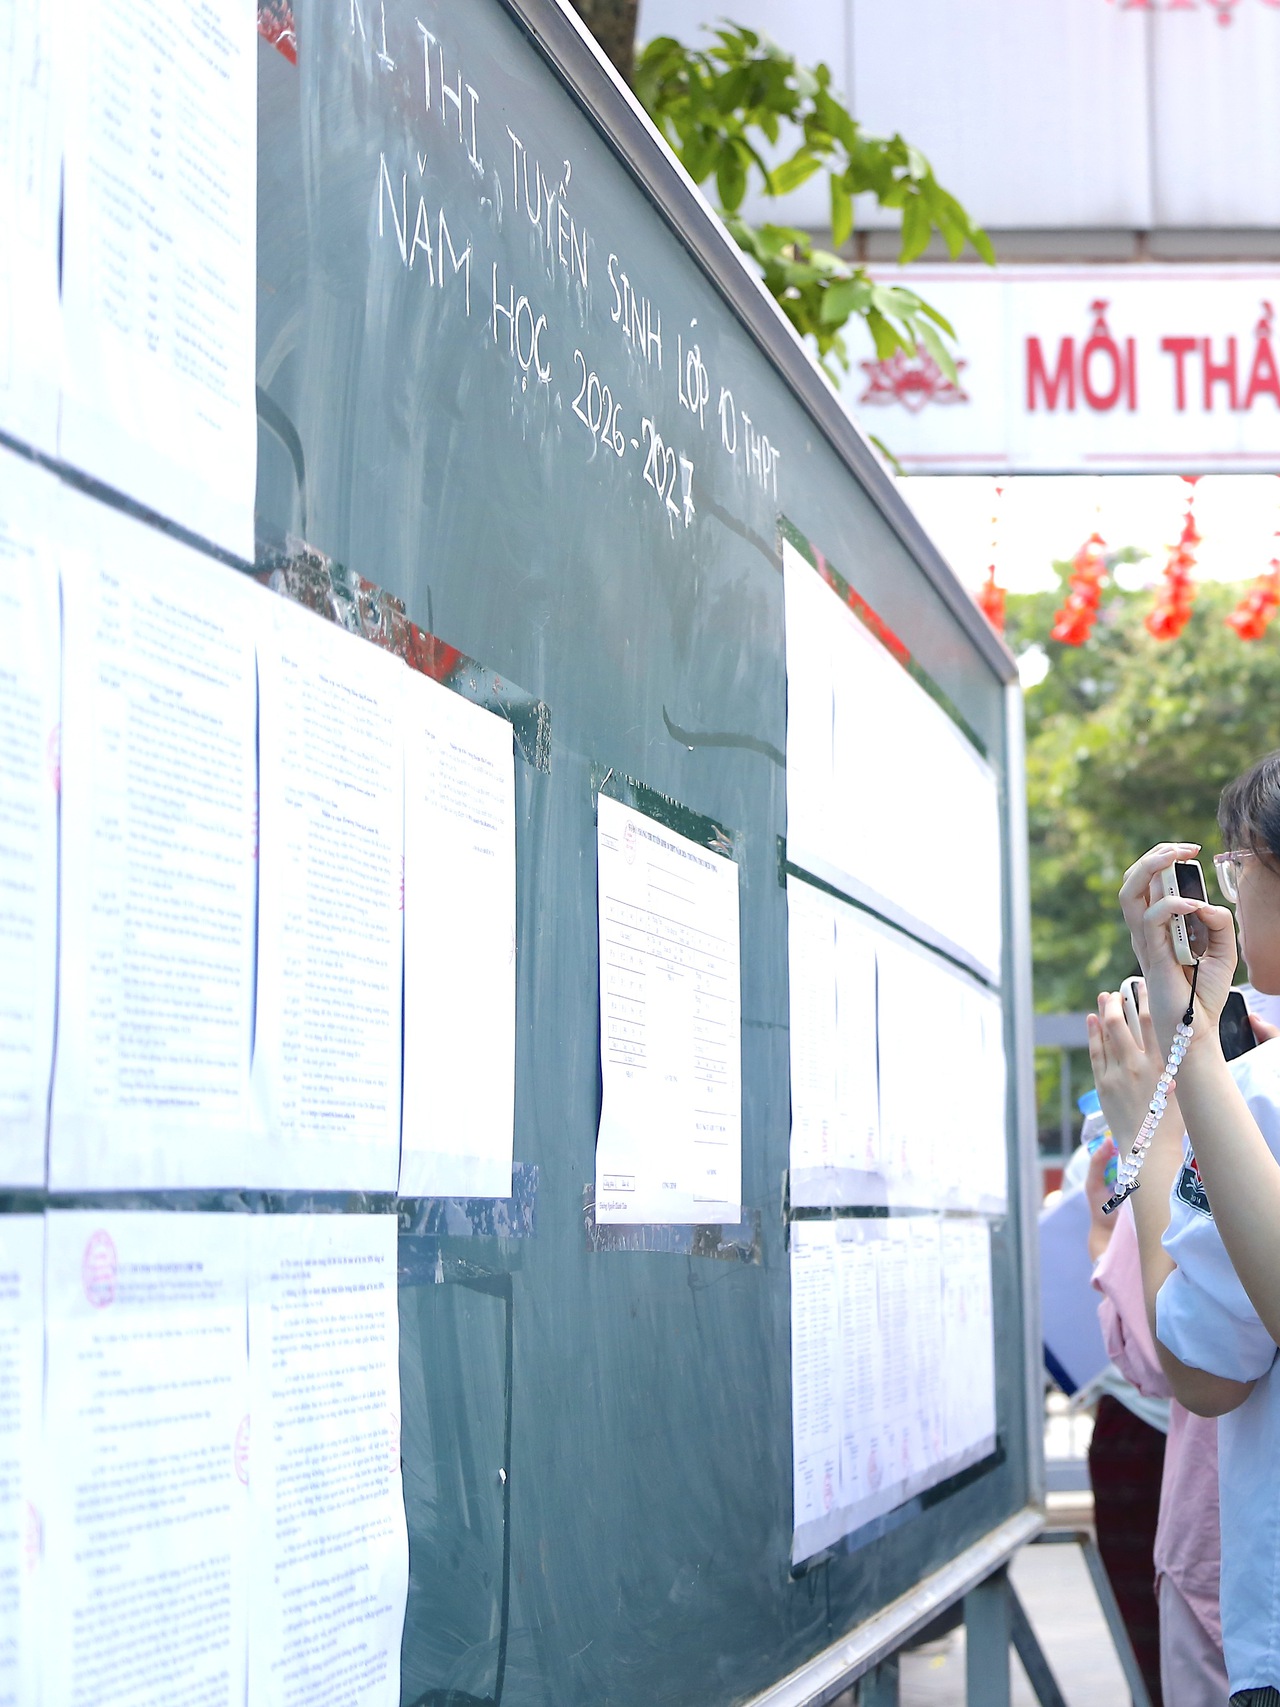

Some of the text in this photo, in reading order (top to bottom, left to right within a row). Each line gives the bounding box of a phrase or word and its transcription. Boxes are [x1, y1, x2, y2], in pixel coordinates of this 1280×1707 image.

[378, 151, 474, 317] NĂM
[491, 261, 553, 394] HỌC
[414, 16, 485, 180] THI
[505, 124, 589, 290] TUYỂN
[607, 253, 663, 372] SINH
[717, 386, 739, 454] 10
[740, 409, 781, 503] THPT
[1024, 299, 1138, 413] MỖI
